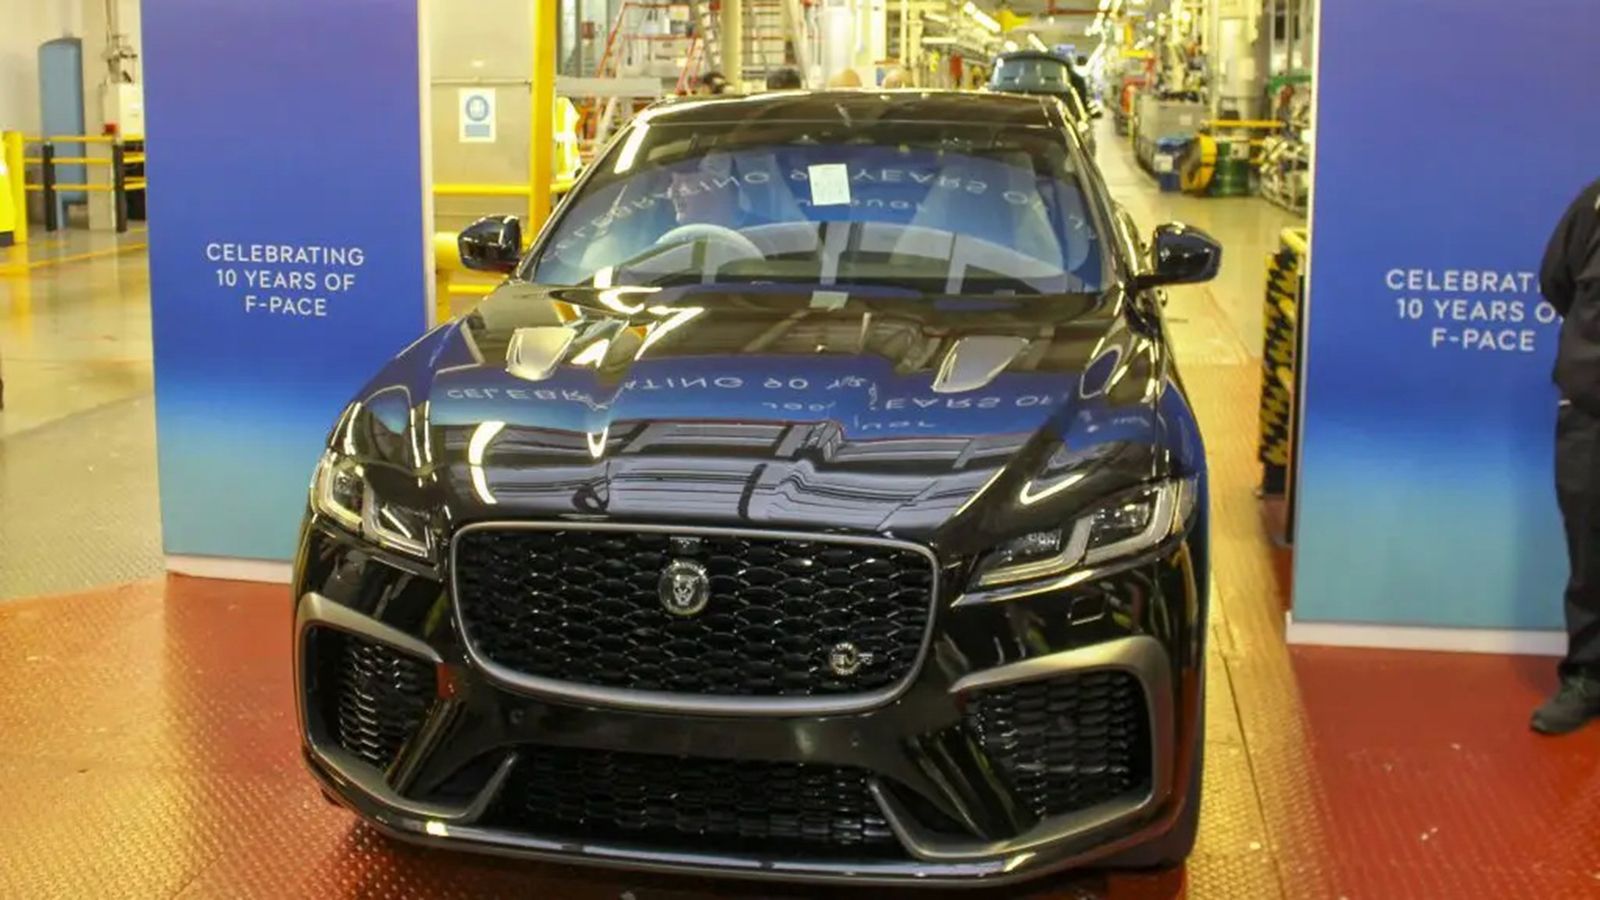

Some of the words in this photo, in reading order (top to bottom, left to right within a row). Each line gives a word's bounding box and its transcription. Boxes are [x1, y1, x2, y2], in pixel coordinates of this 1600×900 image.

[206, 243, 365, 266] CELEBRATING
[215, 268, 237, 287] 10
[244, 270, 317, 290] YEARS
[324, 273, 356, 291] OF
[245, 295, 327, 316] F-PACE
[1396, 298, 1423, 319] 10
[1434, 299, 1525, 322] YEARS
[1534, 302, 1564, 324] O
[1432, 327, 1536, 351] F-PACE
